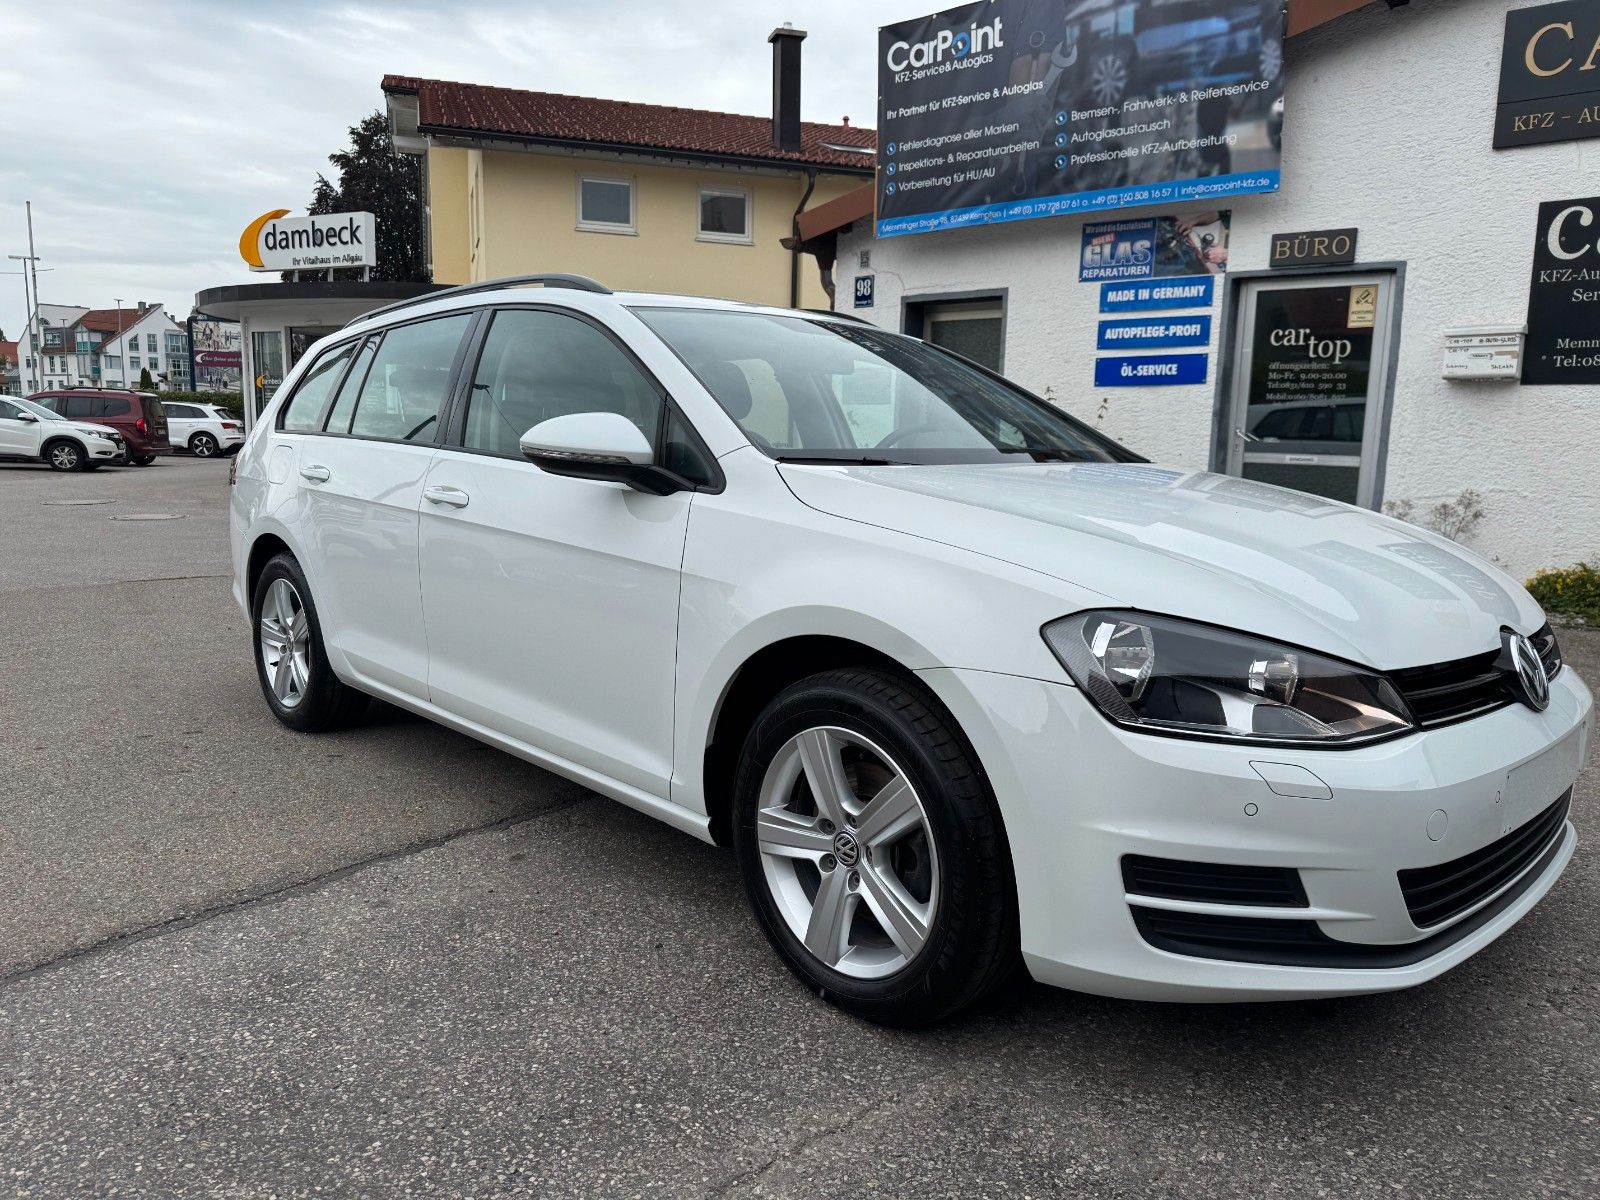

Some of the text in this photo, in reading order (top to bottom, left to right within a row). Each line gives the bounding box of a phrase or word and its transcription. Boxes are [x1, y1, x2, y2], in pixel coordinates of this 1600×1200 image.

[887, 16, 1003, 71] CarPoint
[887, 109, 897, 120] Ihr
[898, 105, 927, 118] Partner
[929, 100, 940, 111] für
[942, 91, 991, 109] KFZ-Service
[1002, 79, 1044, 97] Autoglas
[1071, 79, 1270, 122] Bremsen-, Fahrwerk- & Reifenservice
[1070, 118, 1170, 143] Autoglasaustausch
[1513, 112, 1555, 132] KFZ
[899, 122, 1019, 152] Fehlerdiagnose aller Marken
[1070, 132, 1238, 166] Professionelle KFZ-Aufbereitung
[899, 140, 1040, 173] Inspektions- & Reparaturarbeiten
[899, 167, 996, 192] Vorbereitung für HU/AU
[1034, 204, 1046, 213] 179
[1134, 191, 1149, 201] 808
[1151, 190, 1161, 199] 16
[1161, 188, 1172, 197] 57
[1181, 178, 1270, 196] info@carpoint-kfz.de
[264, 217, 363, 251] dambeck
[292, 253, 363, 266] Ihr Vitalhaus im Allgäu
[1082, 239, 1151, 268] GLAS
[1275, 235, 1350, 259] BÜRO
[1082, 265, 1150, 278] REPARATUREN
[857, 279, 871, 297] 98
[1107, 285, 1206, 303] MADE IN GERMANY
[1105, 324, 1201, 339] AUTOPFLEGE-PROFI
[1270, 327, 1351, 364] car top
[1121, 363, 1178, 377] ÖL-SERVICE
[1268, 371, 1347, 381] Mo-Fr. 9.00-20.00
